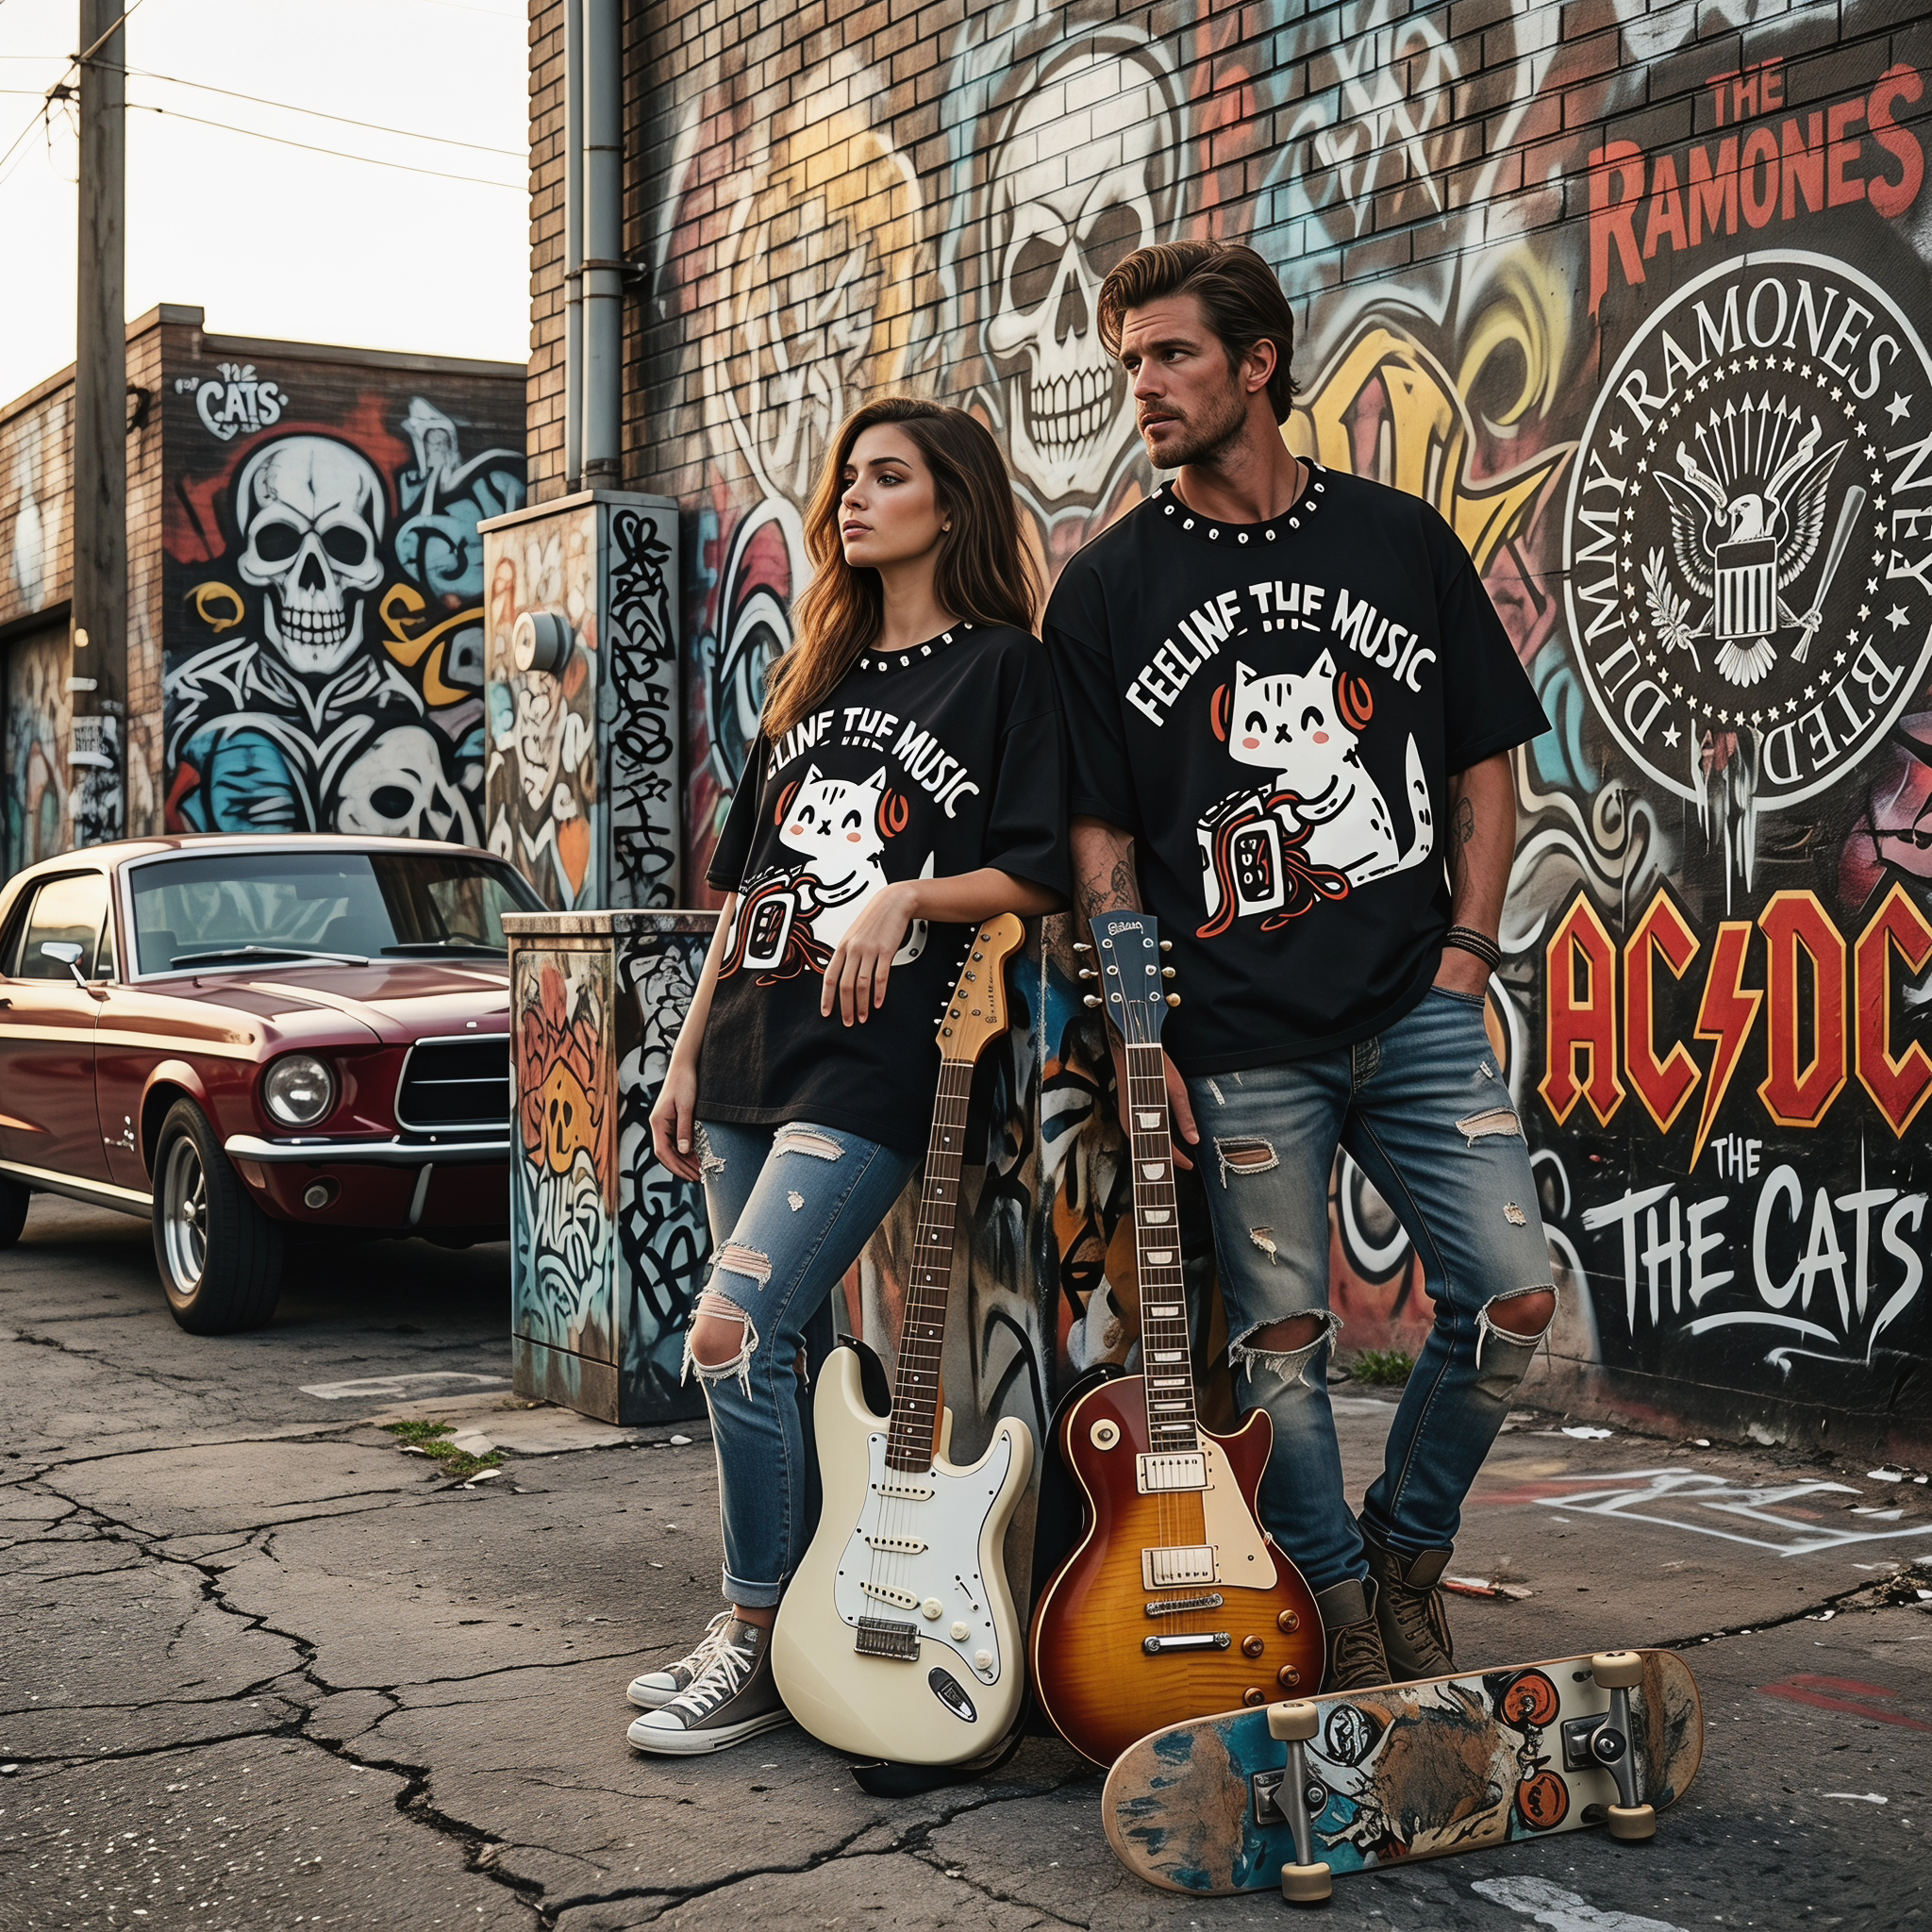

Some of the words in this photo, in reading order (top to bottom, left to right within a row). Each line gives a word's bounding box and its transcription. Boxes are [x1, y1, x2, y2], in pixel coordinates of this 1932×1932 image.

[1705, 57, 1784, 127] THE
[1588, 62, 1924, 325] RAMONES
[1616, 277, 1902, 435] RAMONES
[196, 380, 281, 441] CATS
[1330, 588, 1436, 692] MUSIC
[1575, 448, 1672, 745] DUMMY
[891, 720, 980, 819] MUSIC
[1711, 1133, 1762, 1183] THE
[1580, 1182, 1734, 1338] THE
[1753, 1164, 1928, 1349] CATS
